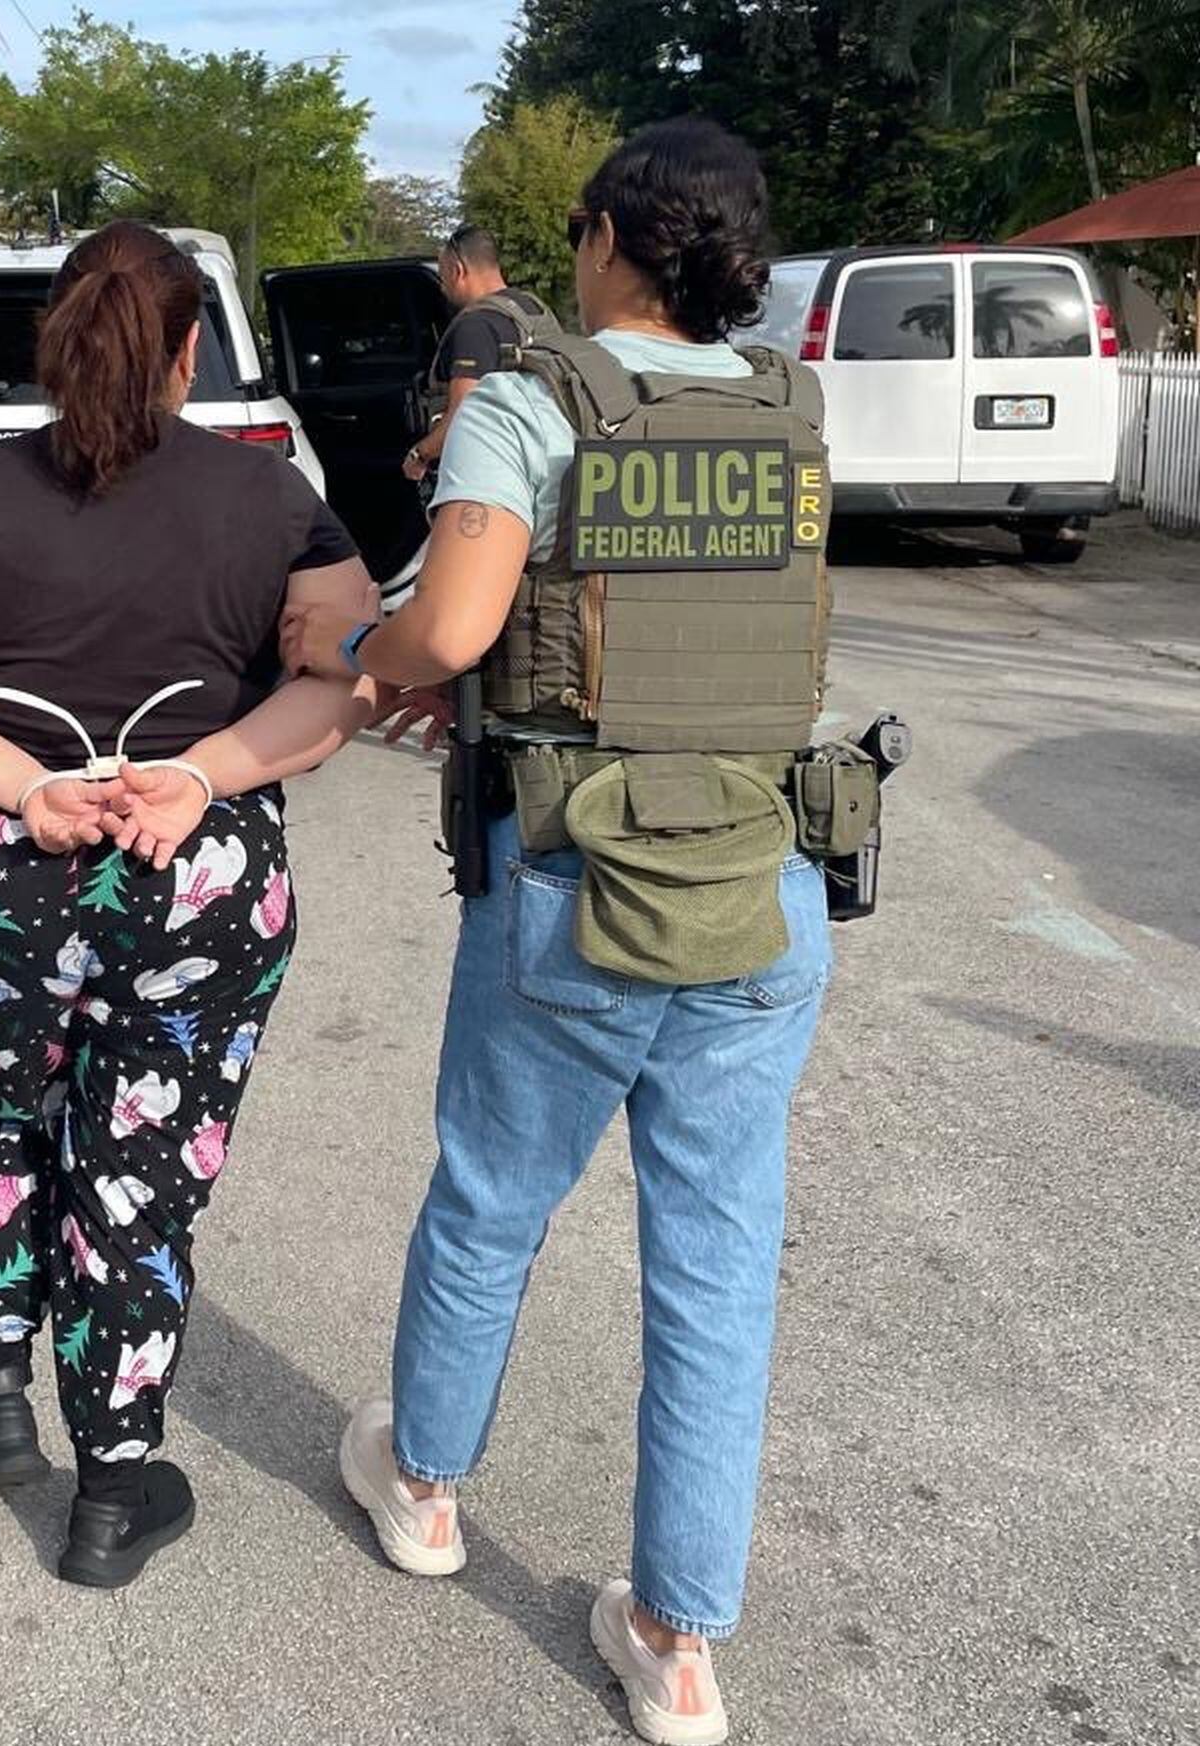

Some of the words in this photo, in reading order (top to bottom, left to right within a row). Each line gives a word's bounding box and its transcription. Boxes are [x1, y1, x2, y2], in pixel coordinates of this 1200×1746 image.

[578, 450, 784, 517] POLICE
[798, 468, 821, 541] ERO
[577, 525, 697, 559] FEDERAL
[705, 524, 786, 557] AGENT
